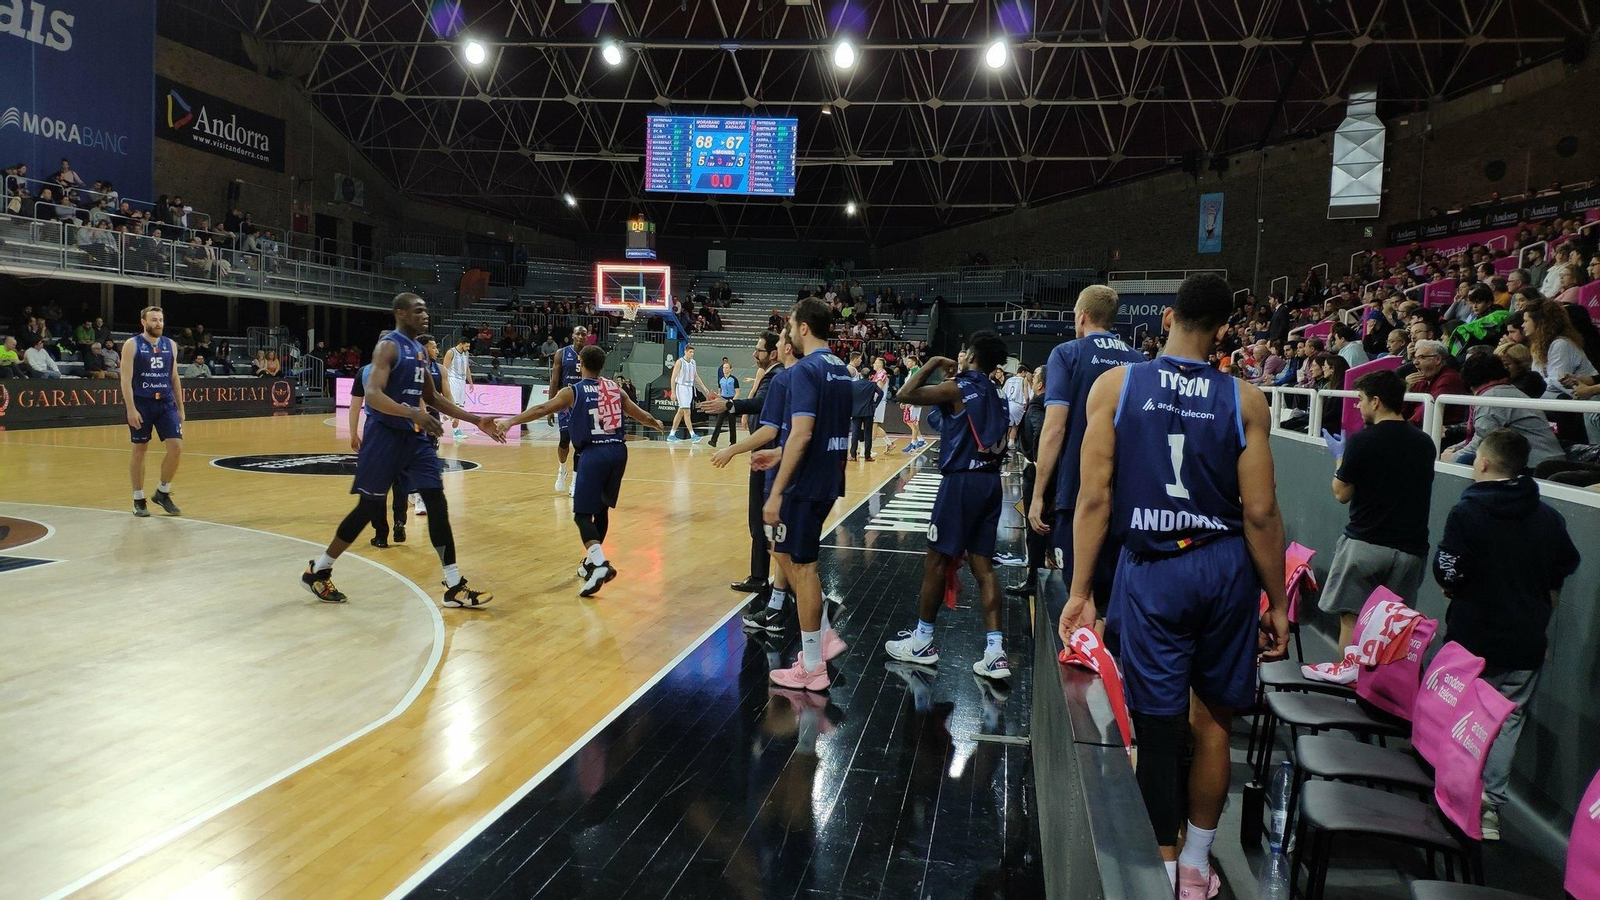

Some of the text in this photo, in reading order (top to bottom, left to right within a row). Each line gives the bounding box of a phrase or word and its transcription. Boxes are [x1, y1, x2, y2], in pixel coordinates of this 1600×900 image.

[23, 112, 128, 155] MORABANC
[193, 105, 269, 152] Andorra
[192, 134, 270, 163] www.visitandorra.com
[695, 136, 744, 149] 68 67
[711, 174, 732, 188] 0.0
[150, 357, 164, 369] 25
[1158, 369, 1210, 398] TYSON
[1166, 434, 1190, 500] 1
[1130, 507, 1229, 531] ANDORRA
[1444, 673, 1465, 693] andorra
[1438, 685, 1458, 707] telecom
